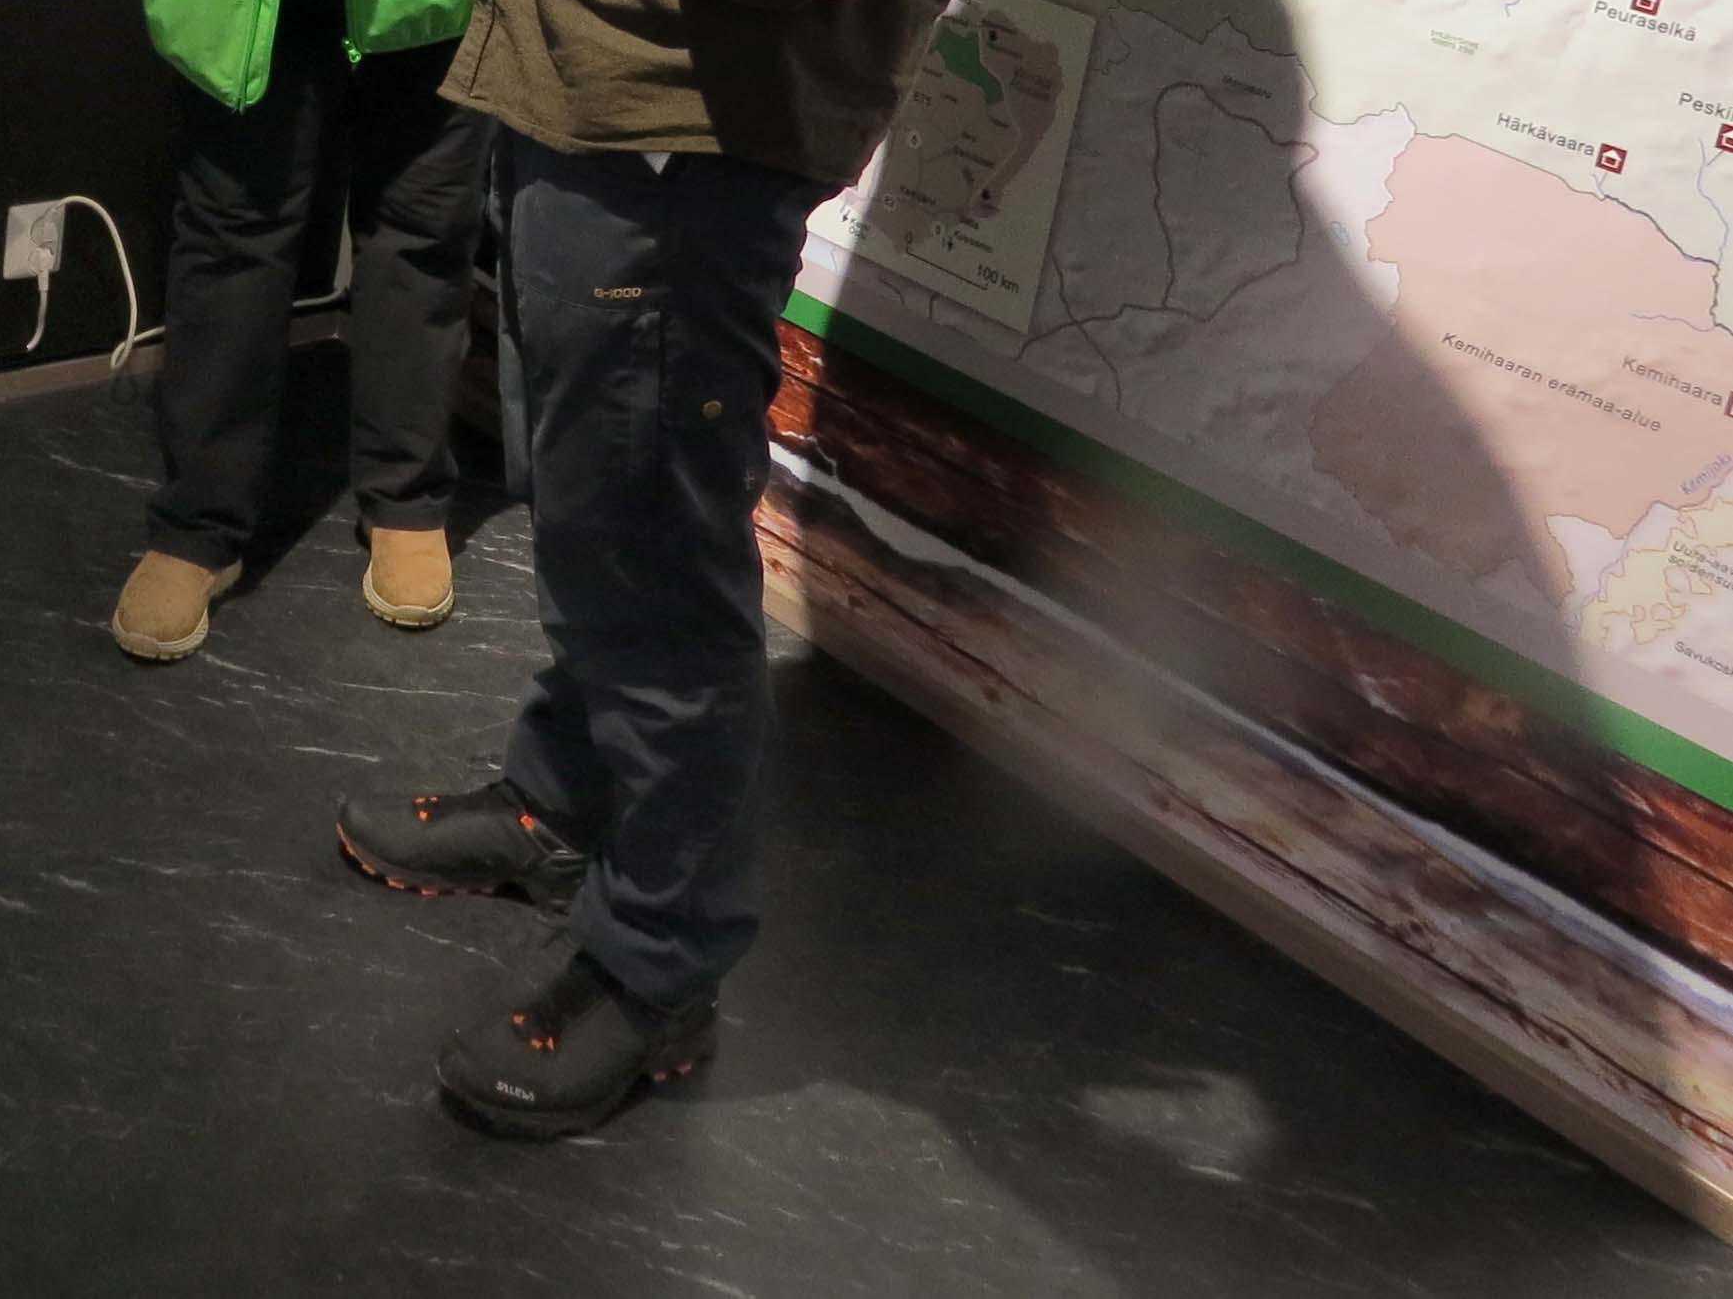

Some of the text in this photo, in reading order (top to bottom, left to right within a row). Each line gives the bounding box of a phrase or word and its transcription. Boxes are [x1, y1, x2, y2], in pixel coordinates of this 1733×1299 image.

[1593, 0, 1697, 42] Peuraselkä
[1678, 92, 1733, 122] Peski
[1496, 111, 1596, 157] Härkävaara
[977, 264, 1020, 294] 100 km
[1441, 331, 1663, 433] Kemihaaran erämaa-alue
[1621, 354, 1725, 407] Kemihaara
